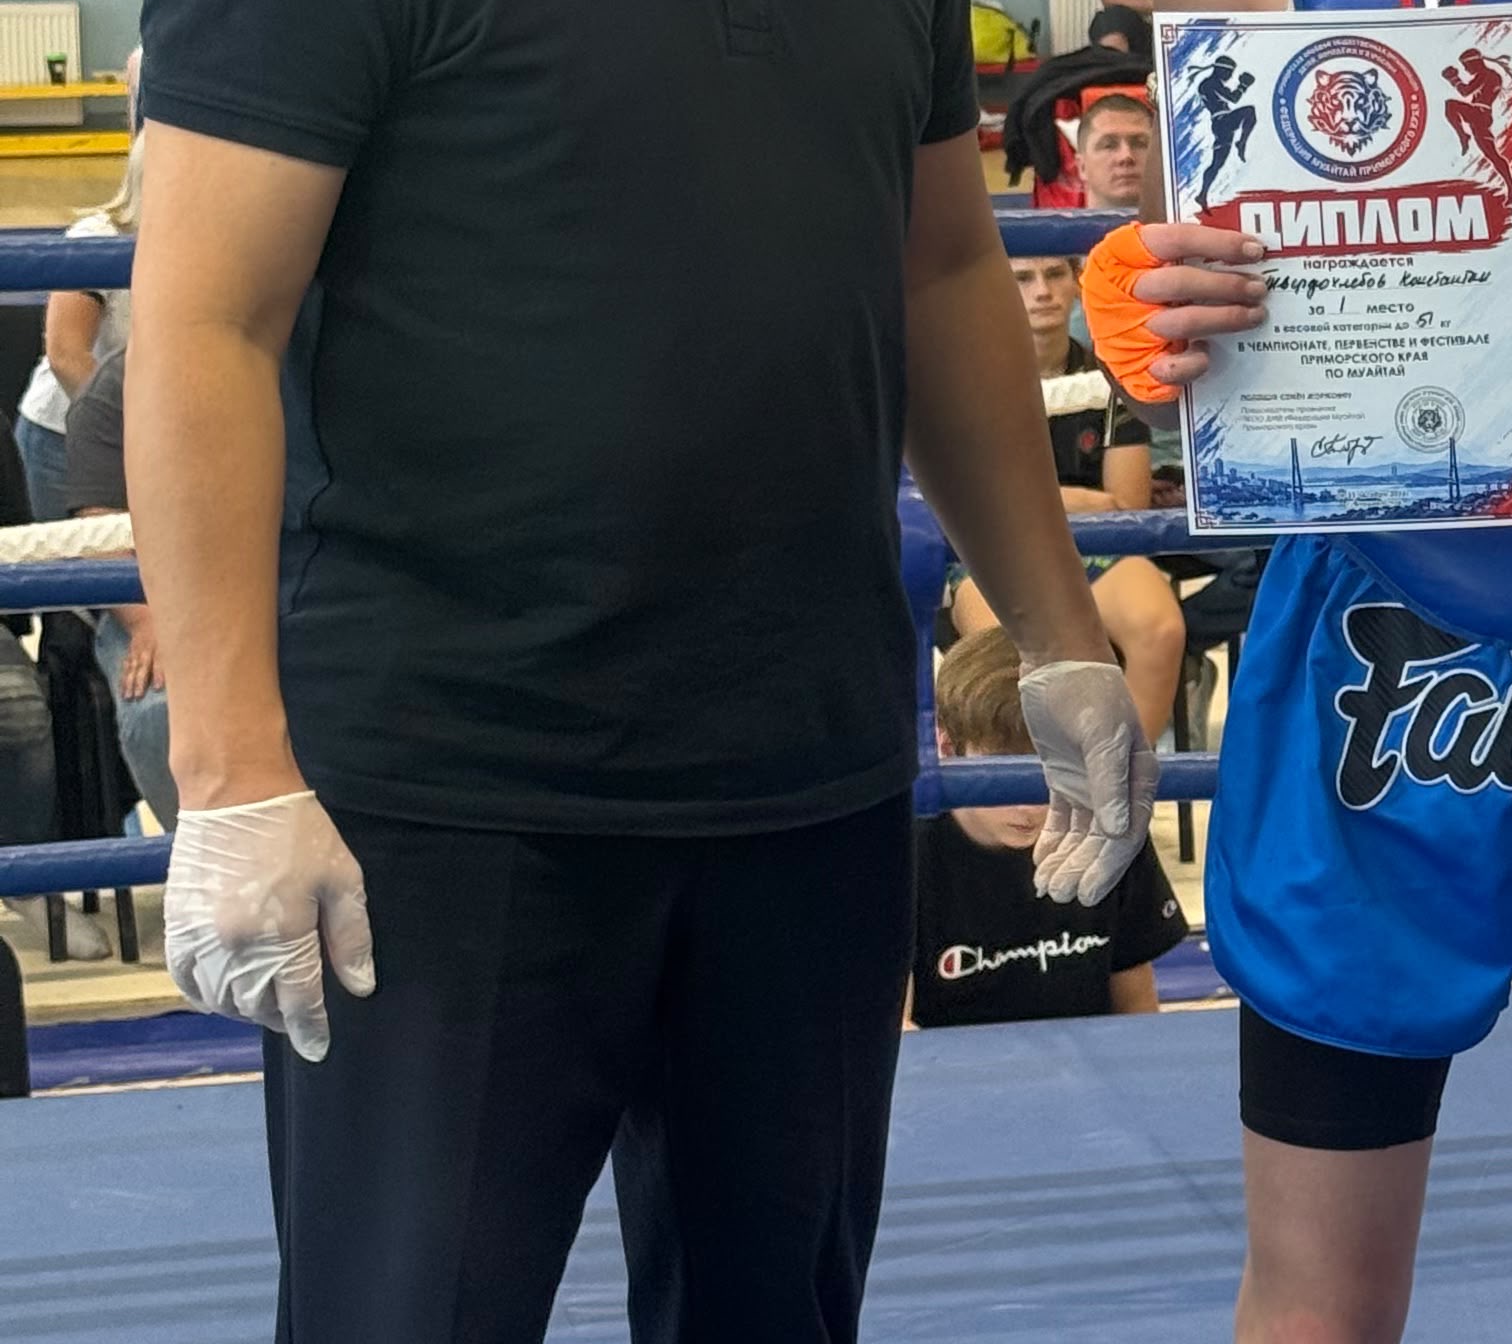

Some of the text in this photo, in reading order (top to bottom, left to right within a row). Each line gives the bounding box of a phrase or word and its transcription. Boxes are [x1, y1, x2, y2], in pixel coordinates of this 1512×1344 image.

[1240, 194, 1490, 251] ДИПЛОМ
[1303, 257, 1414, 271] награждается
[1308, 306, 1325, 315] за
[1366, 303, 1415, 314] место
[1283, 321, 1330, 333] весовой
[1333, 323, 1392, 334] категории
[1238, 342, 1245, 352] В
[1335, 337, 1407, 350] ПЕРВЕНСТВЕ
[1409, 336, 1417, 347] И
[1420, 333, 1490, 347] ФЕСТИВАЛЕ
[1301, 351, 1428, 365] ПРИМОРСКОГО КРАЯ
[1325, 364, 1405, 379] ПО МУАЙТАЙ
[938, 929, 1111, 980] Champion
